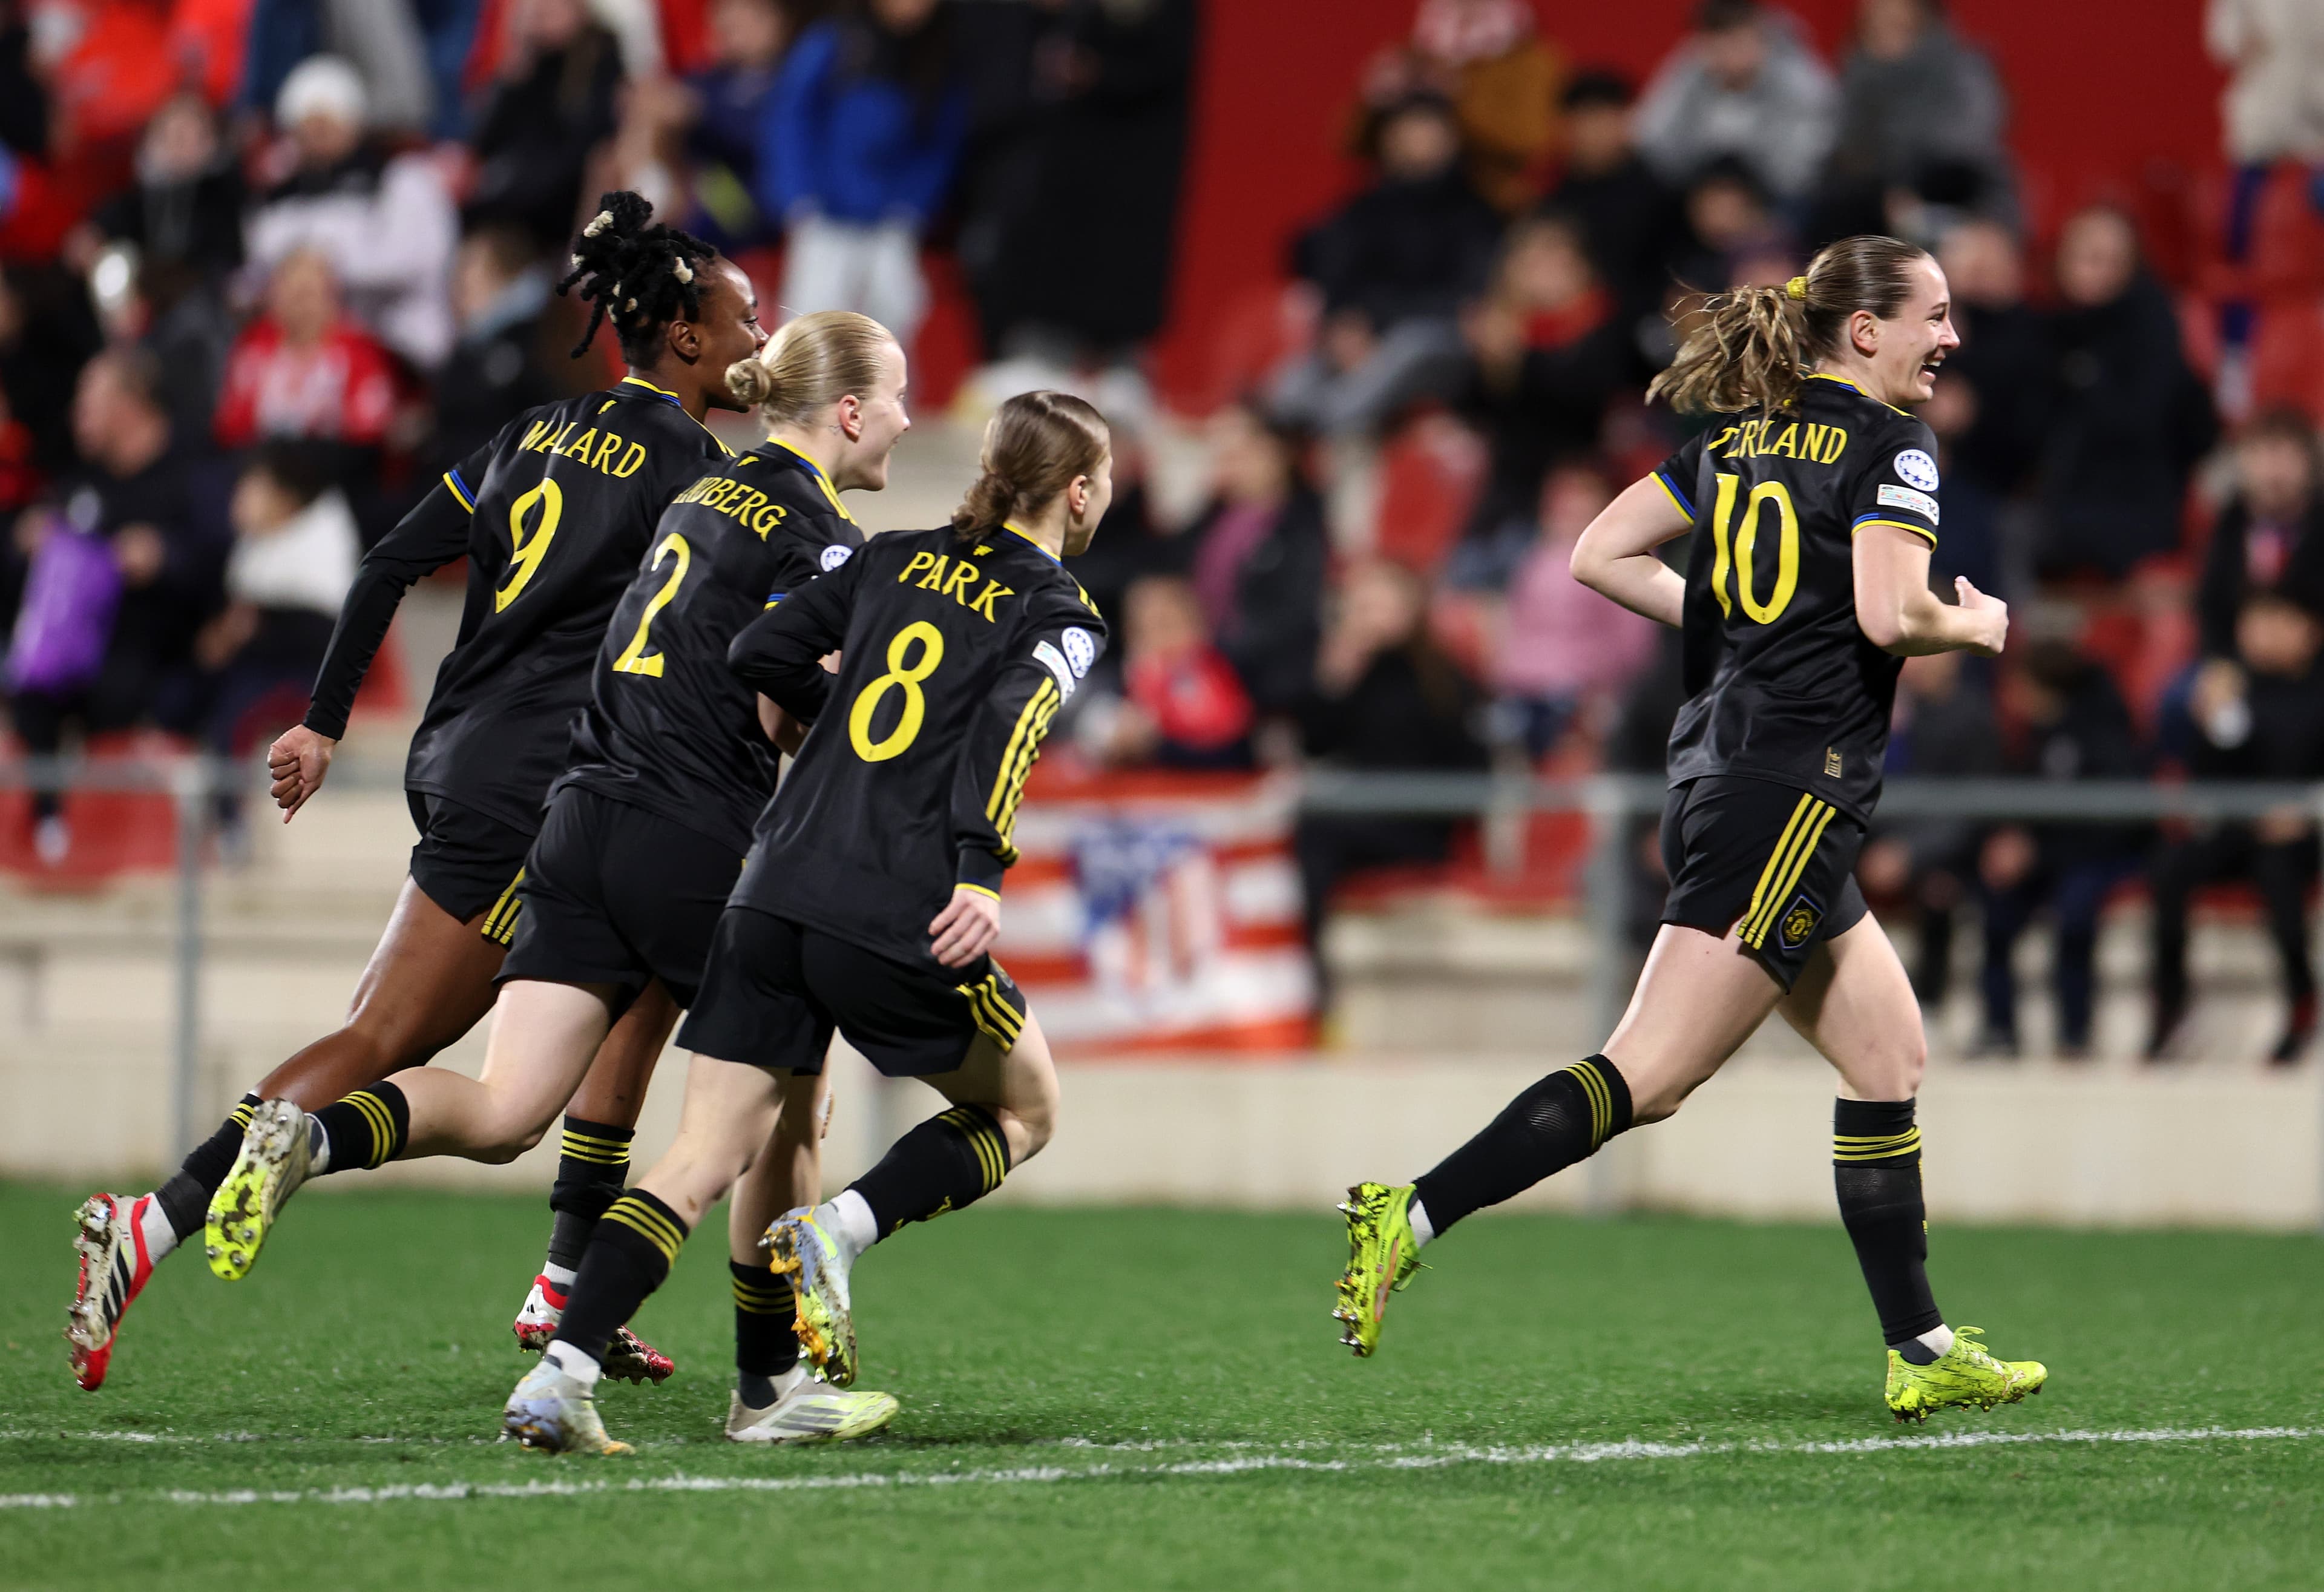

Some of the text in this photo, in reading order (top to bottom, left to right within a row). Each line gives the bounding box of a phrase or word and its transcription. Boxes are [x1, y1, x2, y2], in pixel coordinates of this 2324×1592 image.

[517, 421, 646, 478] MALARD
[495, 477, 563, 614] 9
[612, 533, 691, 679] 2
[898, 551, 1015, 623] PARK
[1711, 473, 1799, 625] 10
[849, 620, 944, 763] 8
